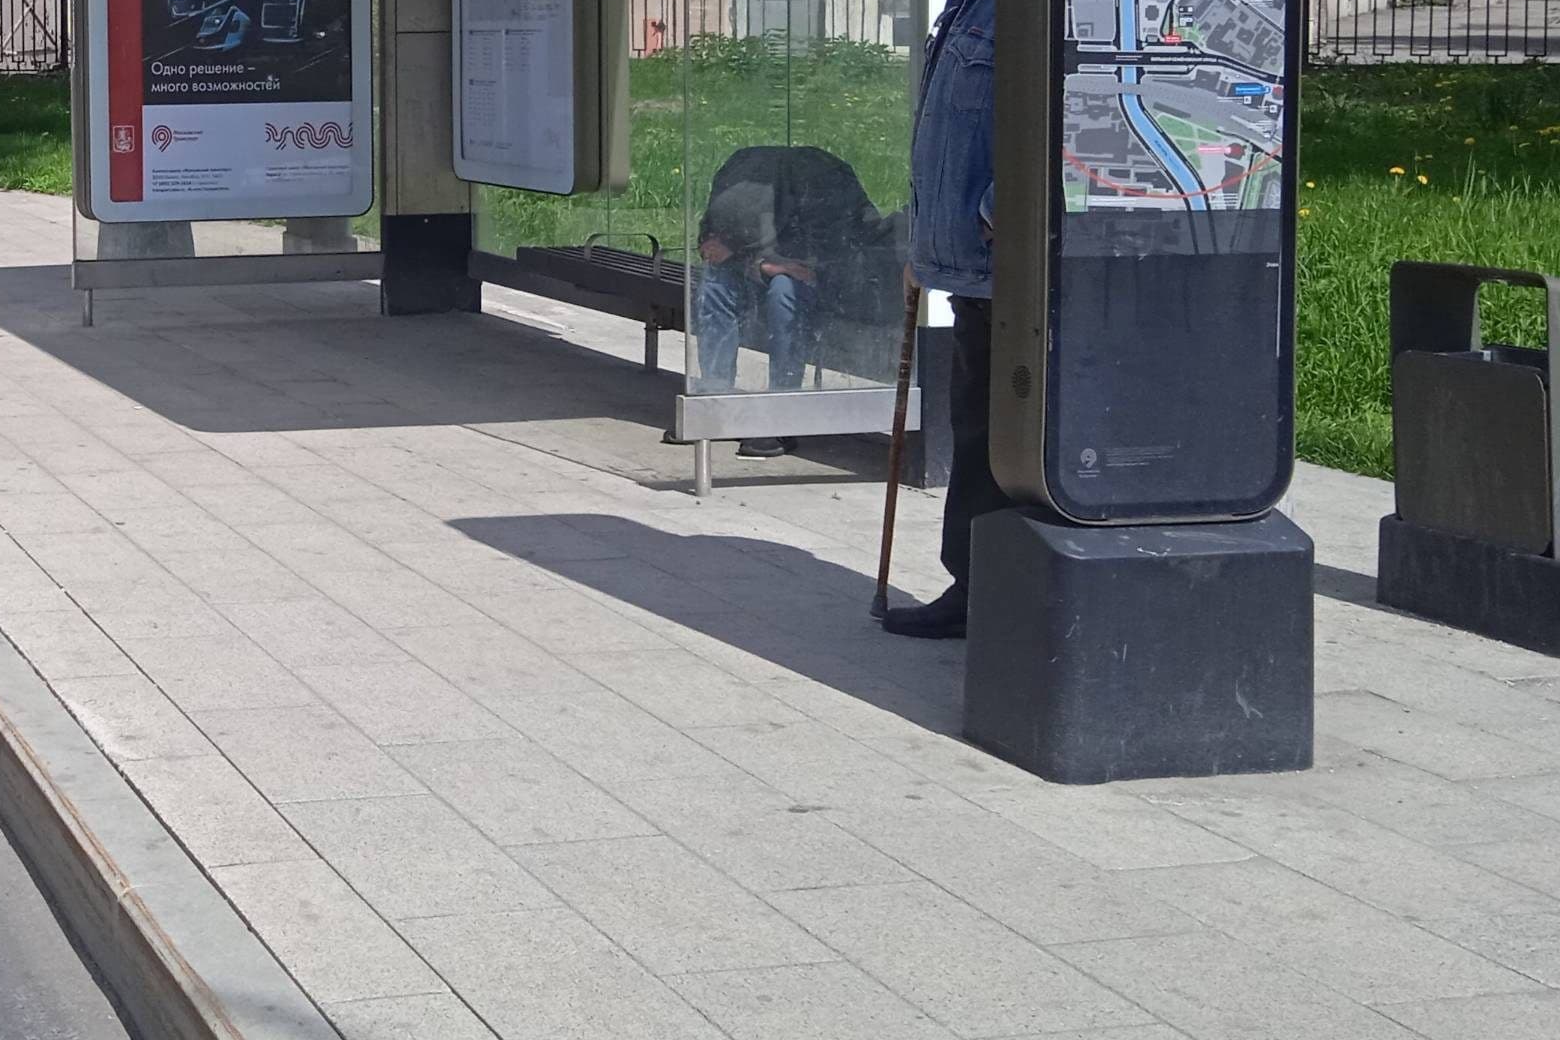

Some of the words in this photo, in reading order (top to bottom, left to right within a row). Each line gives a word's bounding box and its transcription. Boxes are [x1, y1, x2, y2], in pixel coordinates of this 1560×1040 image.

[151, 61, 186, 76] Одно
[189, 64, 245, 78] решение
[151, 82, 189, 93] много
[191, 77, 280, 93] возможностей
